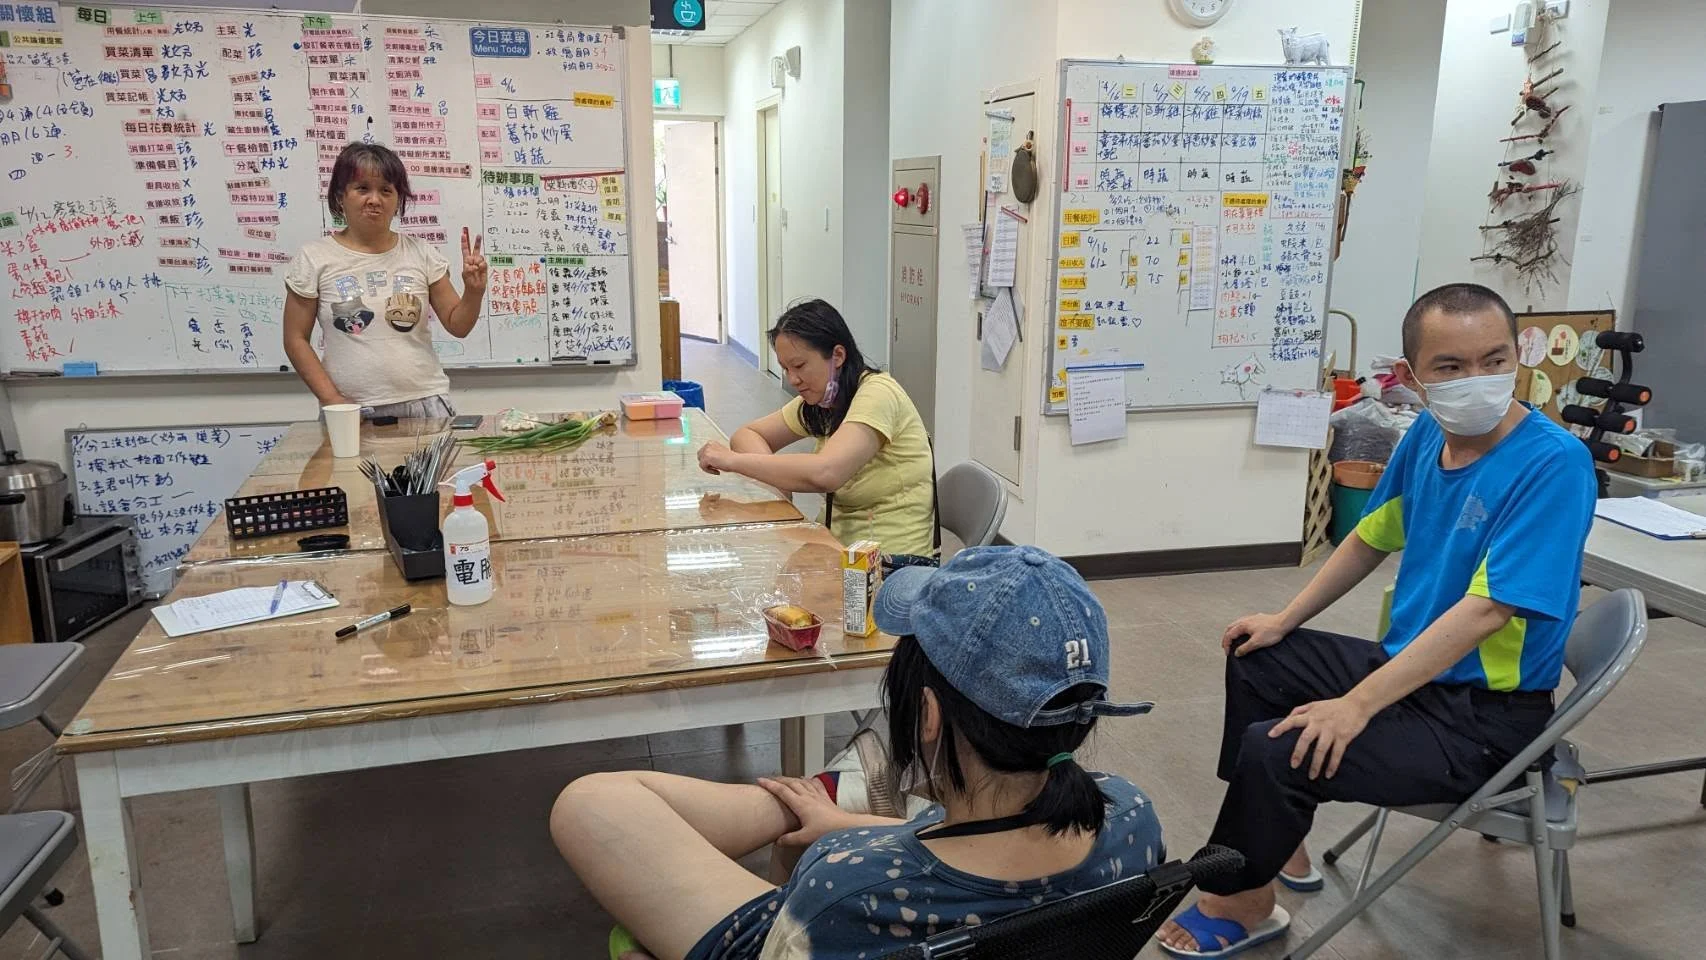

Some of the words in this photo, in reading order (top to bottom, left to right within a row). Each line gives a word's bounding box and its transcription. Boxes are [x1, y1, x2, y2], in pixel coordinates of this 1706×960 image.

[78, 7, 108, 24] 每日
[137, 12, 157, 23] 上午
[305, 17, 326, 27] 下午
[216, 26, 237, 36] 主菜
[472, 30, 527, 44] 今日菜單
[303, 41, 360, 50] 放訂餐表在櫃台
[474, 44, 499, 54] Menu
[501, 44, 527, 55] Today
[105, 46, 154, 59] 買菜清單
[223, 49, 244, 60] 配菜
[309, 55, 338, 64] 寫菜單
[120, 69, 142, 80] 買菜
[234, 92, 254, 101] 青菜
[482, 108, 497, 116] 主菜
[125, 122, 197, 133] 每日花費統計
[394, 120, 442, 129] 消毒會所椅子
[482, 130, 497, 138] 配菜
[225, 143, 269, 154] 午餐檢體
[135, 160, 177, 170] 準備餐具
[483, 170, 534, 185] 待辦事項
[1064, 213, 1099, 224] 用餐統計
[1065, 639, 1092, 669] 21
